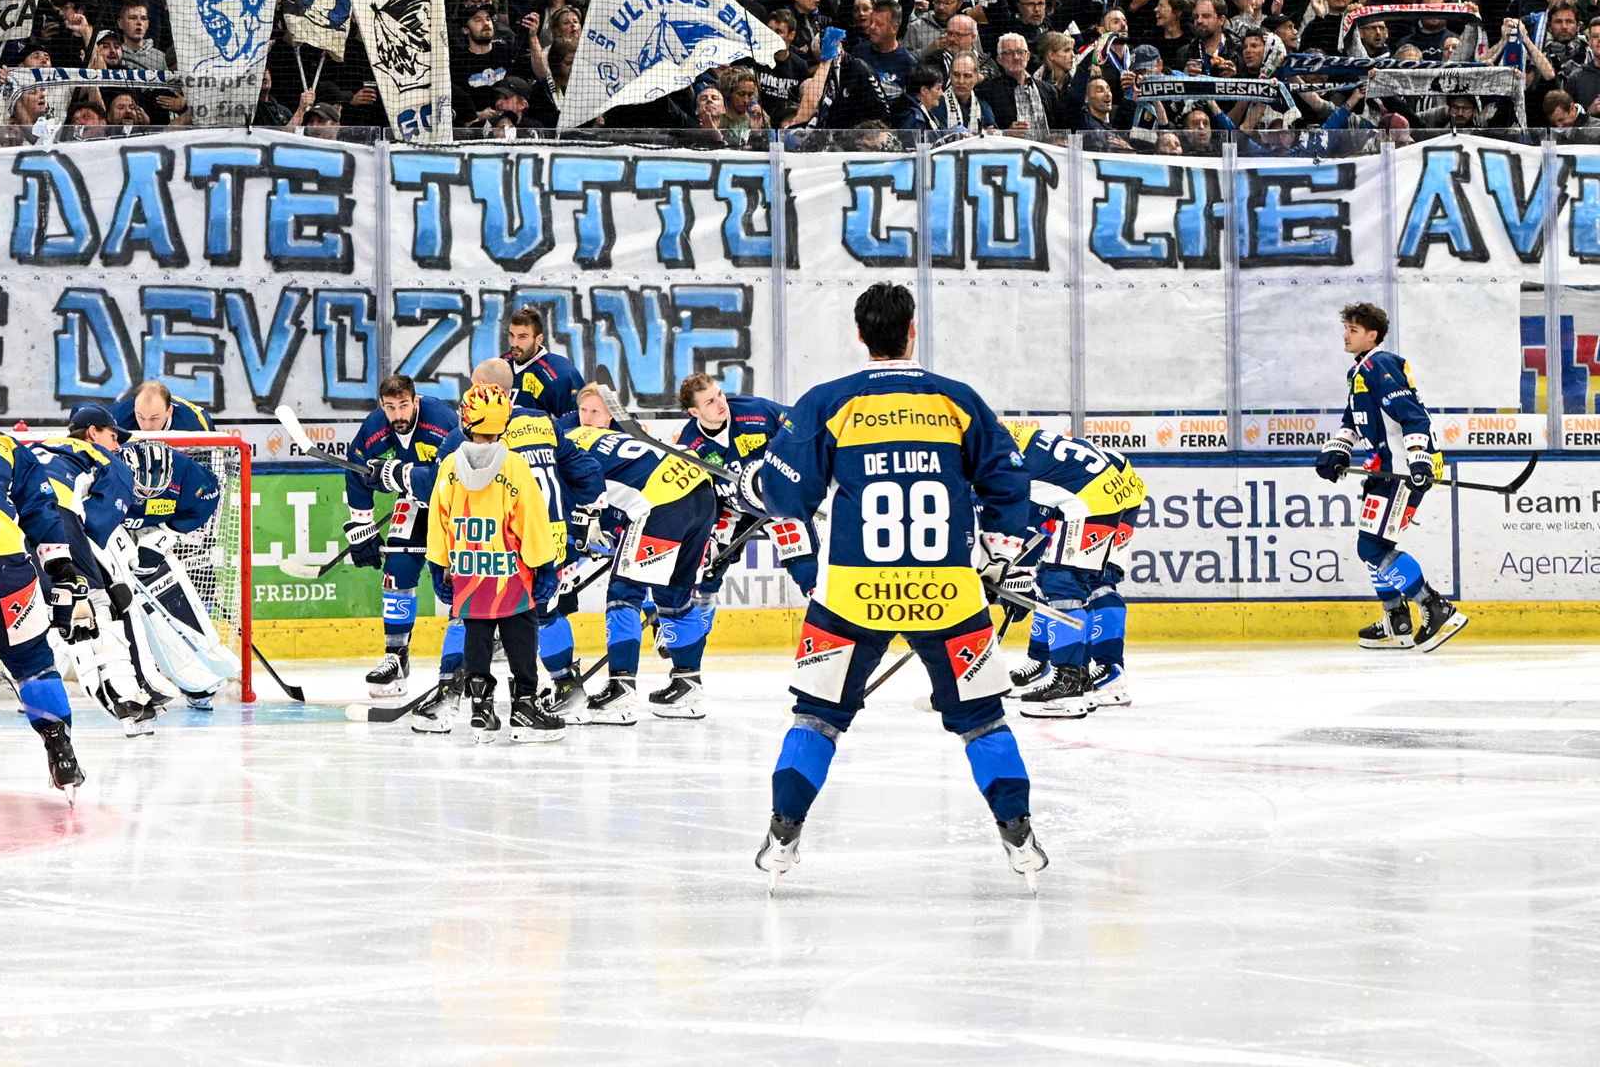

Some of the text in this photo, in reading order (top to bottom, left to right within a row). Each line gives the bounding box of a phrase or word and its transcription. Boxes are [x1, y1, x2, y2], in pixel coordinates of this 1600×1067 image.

[8, 141, 356, 273] DATE
[391, 151, 798, 273] TUTTO
[1089, 159, 1357, 270] CHE
[1084, 420, 1131, 433] ENNIO
[1180, 419, 1227, 432] ENNIO
[1268, 418, 1316, 431] ENNIO
[1468, 417, 1517, 431] ENNIO
[1565, 418, 1600, 431] ENNI
[1180, 435, 1227, 447] FERRA
[1268, 433, 1331, 446] FERRARI
[1468, 432, 1532, 445] FERRARI
[863, 451, 941, 476] DE LUCA
[1501, 490, 1581, 514] Team
[861, 480, 950, 562] 88
[1502, 519, 1598, 532] we care, we listen,
[453, 517, 497, 543] TOP
[1289, 549, 1344, 583] sa
[879, 569, 936, 580] CAFFÈ
[254, 583, 337, 601] FREDDE
[854, 582, 958, 601] CHICCO
[866, 603, 945, 622] D'ORO
